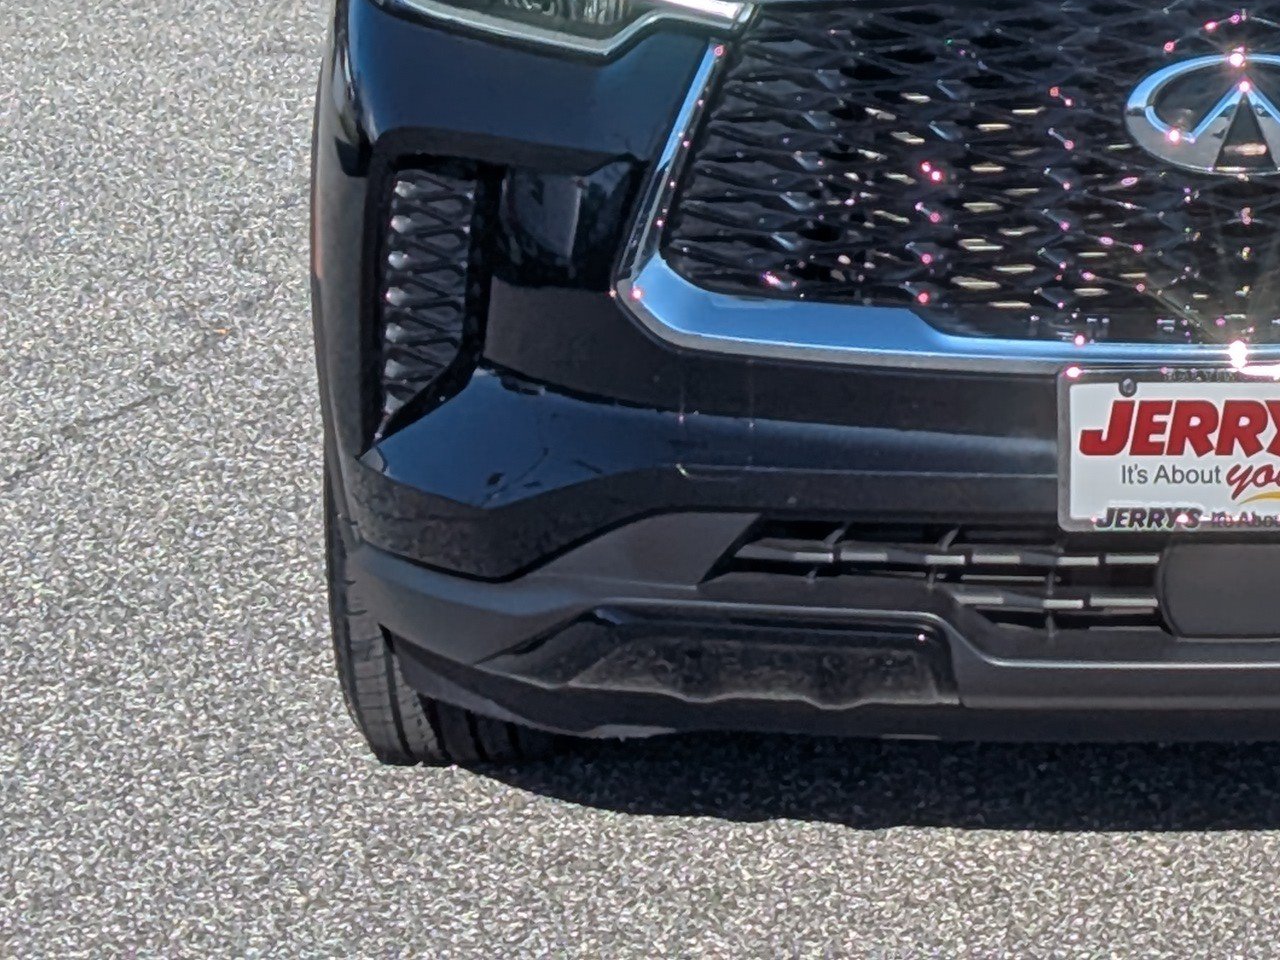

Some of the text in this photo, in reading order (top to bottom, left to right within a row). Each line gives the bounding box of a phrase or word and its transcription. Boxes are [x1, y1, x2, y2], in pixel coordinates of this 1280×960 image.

[1121, 464, 1149, 484] It's
[1153, 464, 1222, 484] About
[1095, 507, 1203, 528] JERRY'S
